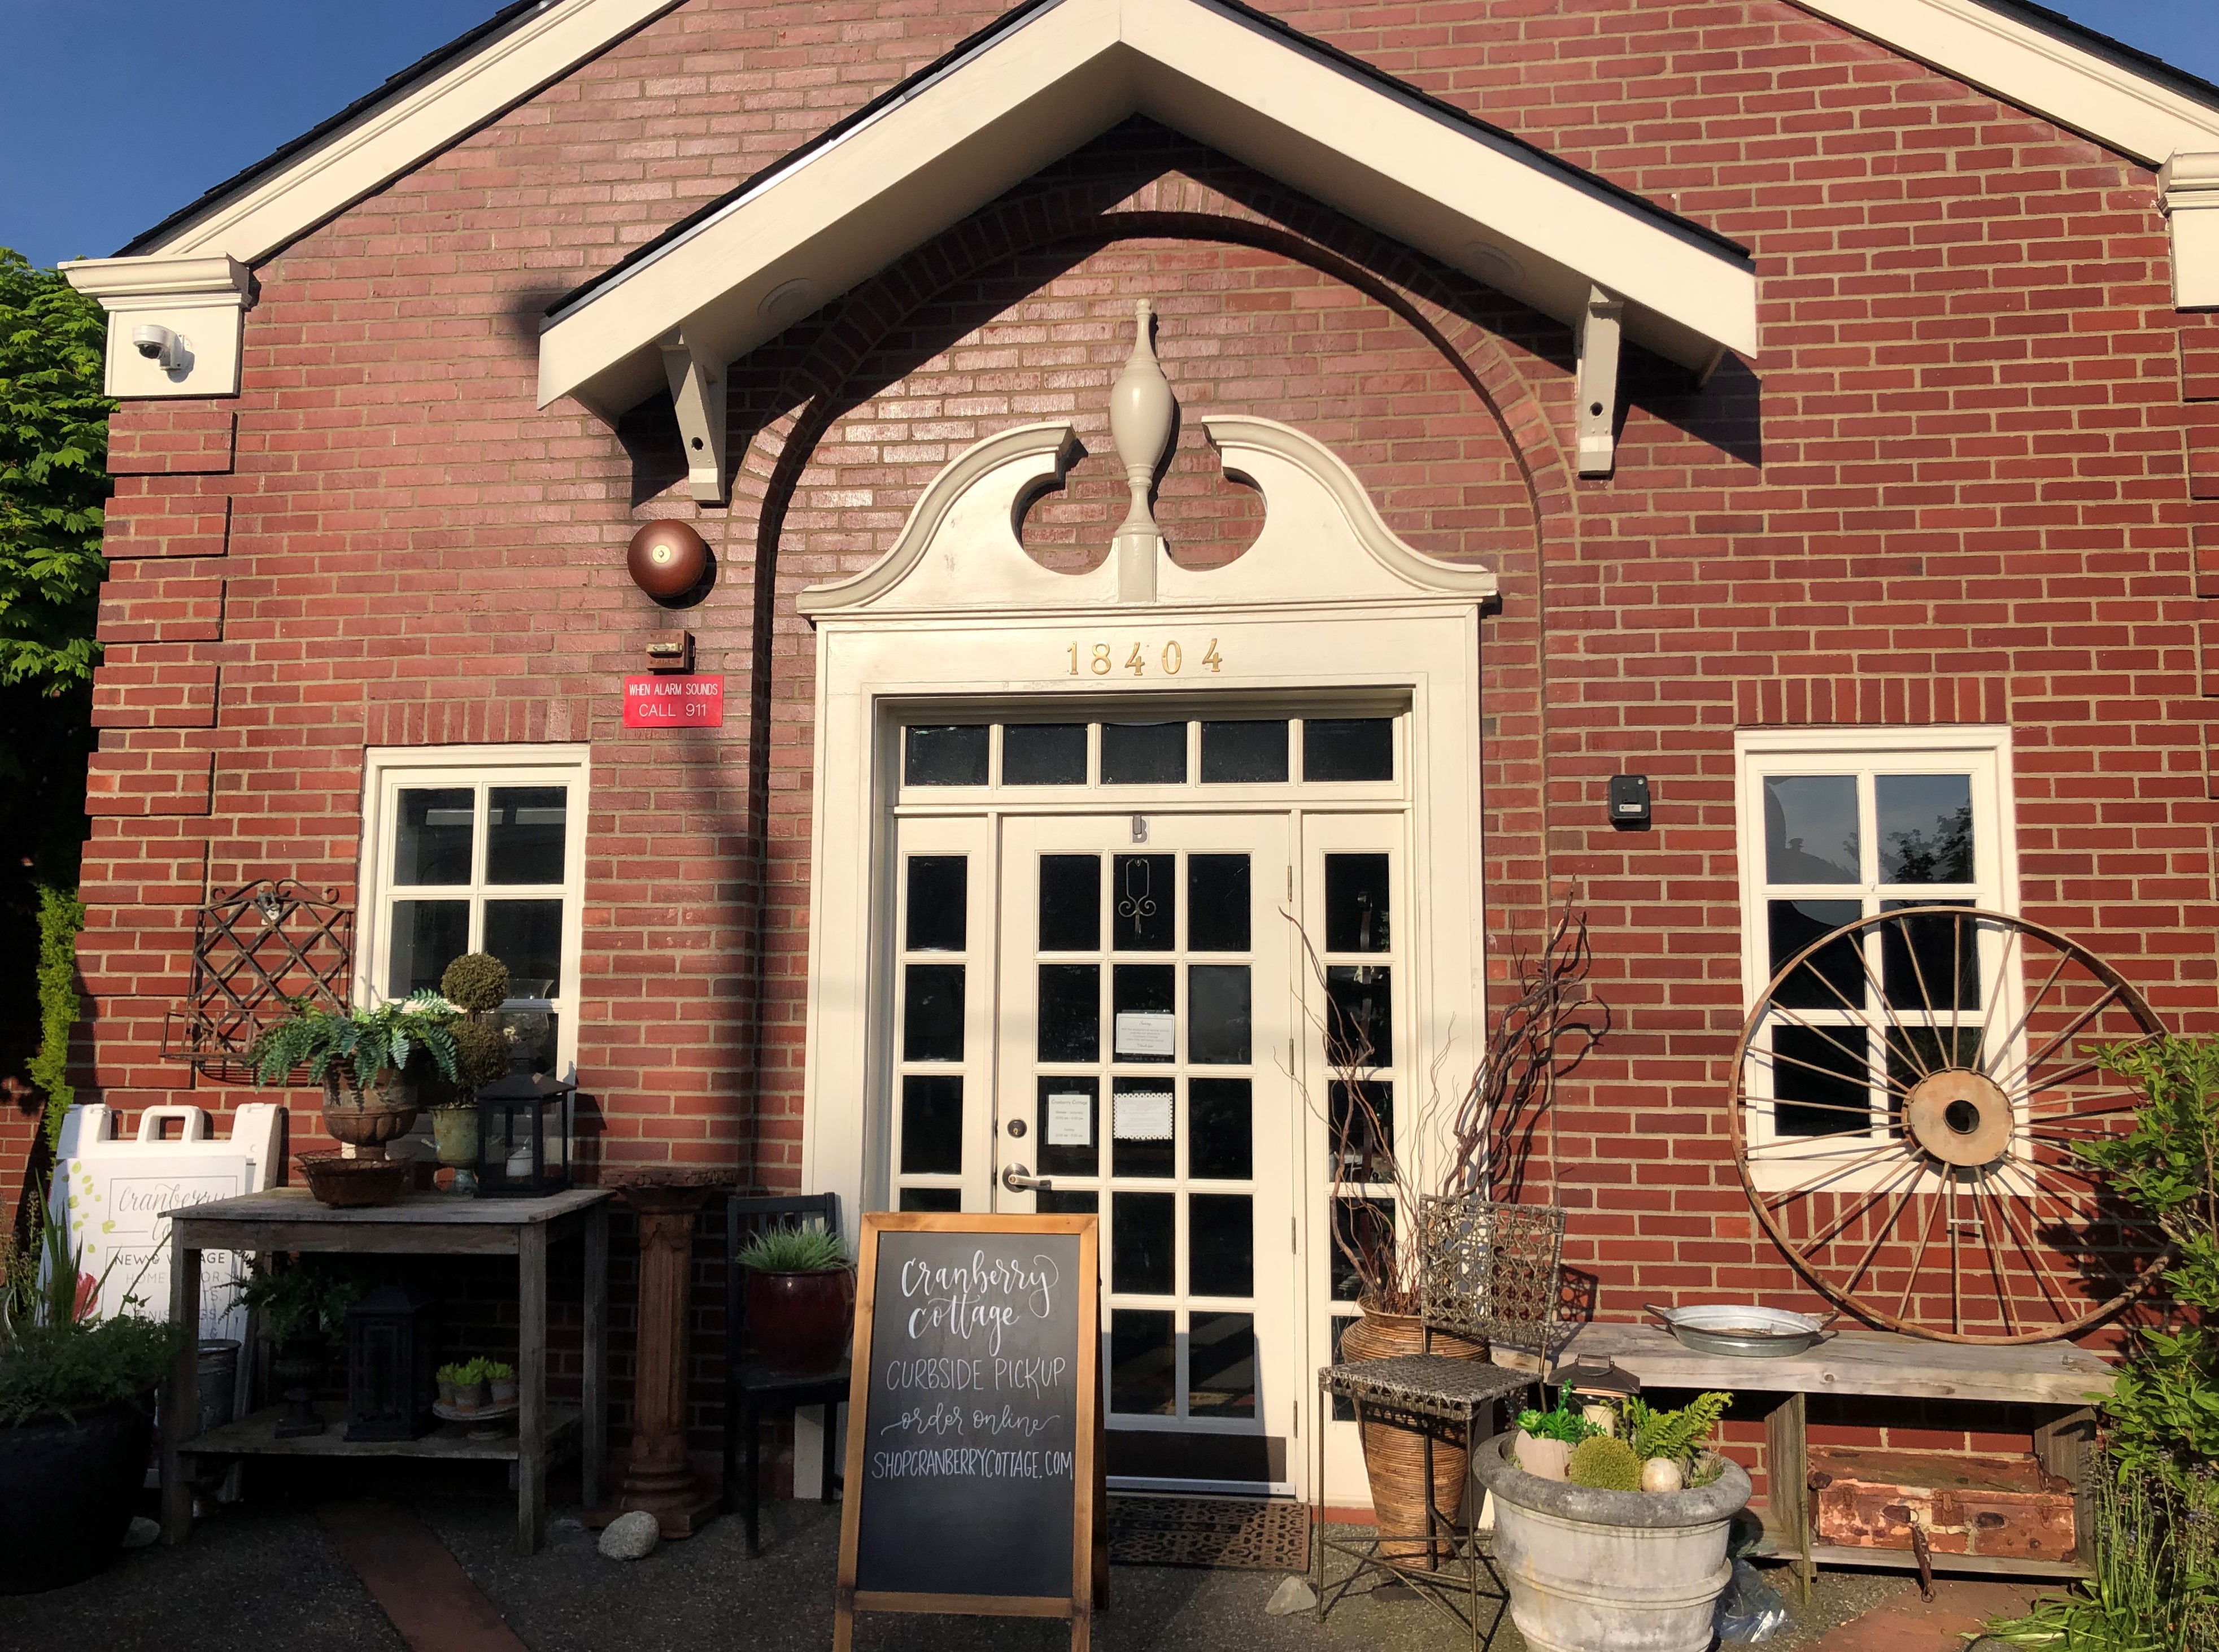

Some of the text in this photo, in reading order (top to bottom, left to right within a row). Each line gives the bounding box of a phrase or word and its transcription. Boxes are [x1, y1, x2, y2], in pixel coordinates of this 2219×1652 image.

[1067, 638, 1223, 676] 18404
[629, 683, 718, 696] WHEN ALARM SOUNDS
[639, 703, 706, 717] CALL 911
[1132, 818, 1148, 843] B
[115, 1254, 150, 1266] NEW
[126, 1271, 165, 1284] HOME
[902, 1250, 1059, 1318] Cranberry
[886, 1357, 1066, 1400] CURBSIDE PICKUP
[881, 1402, 1060, 1437] order online
